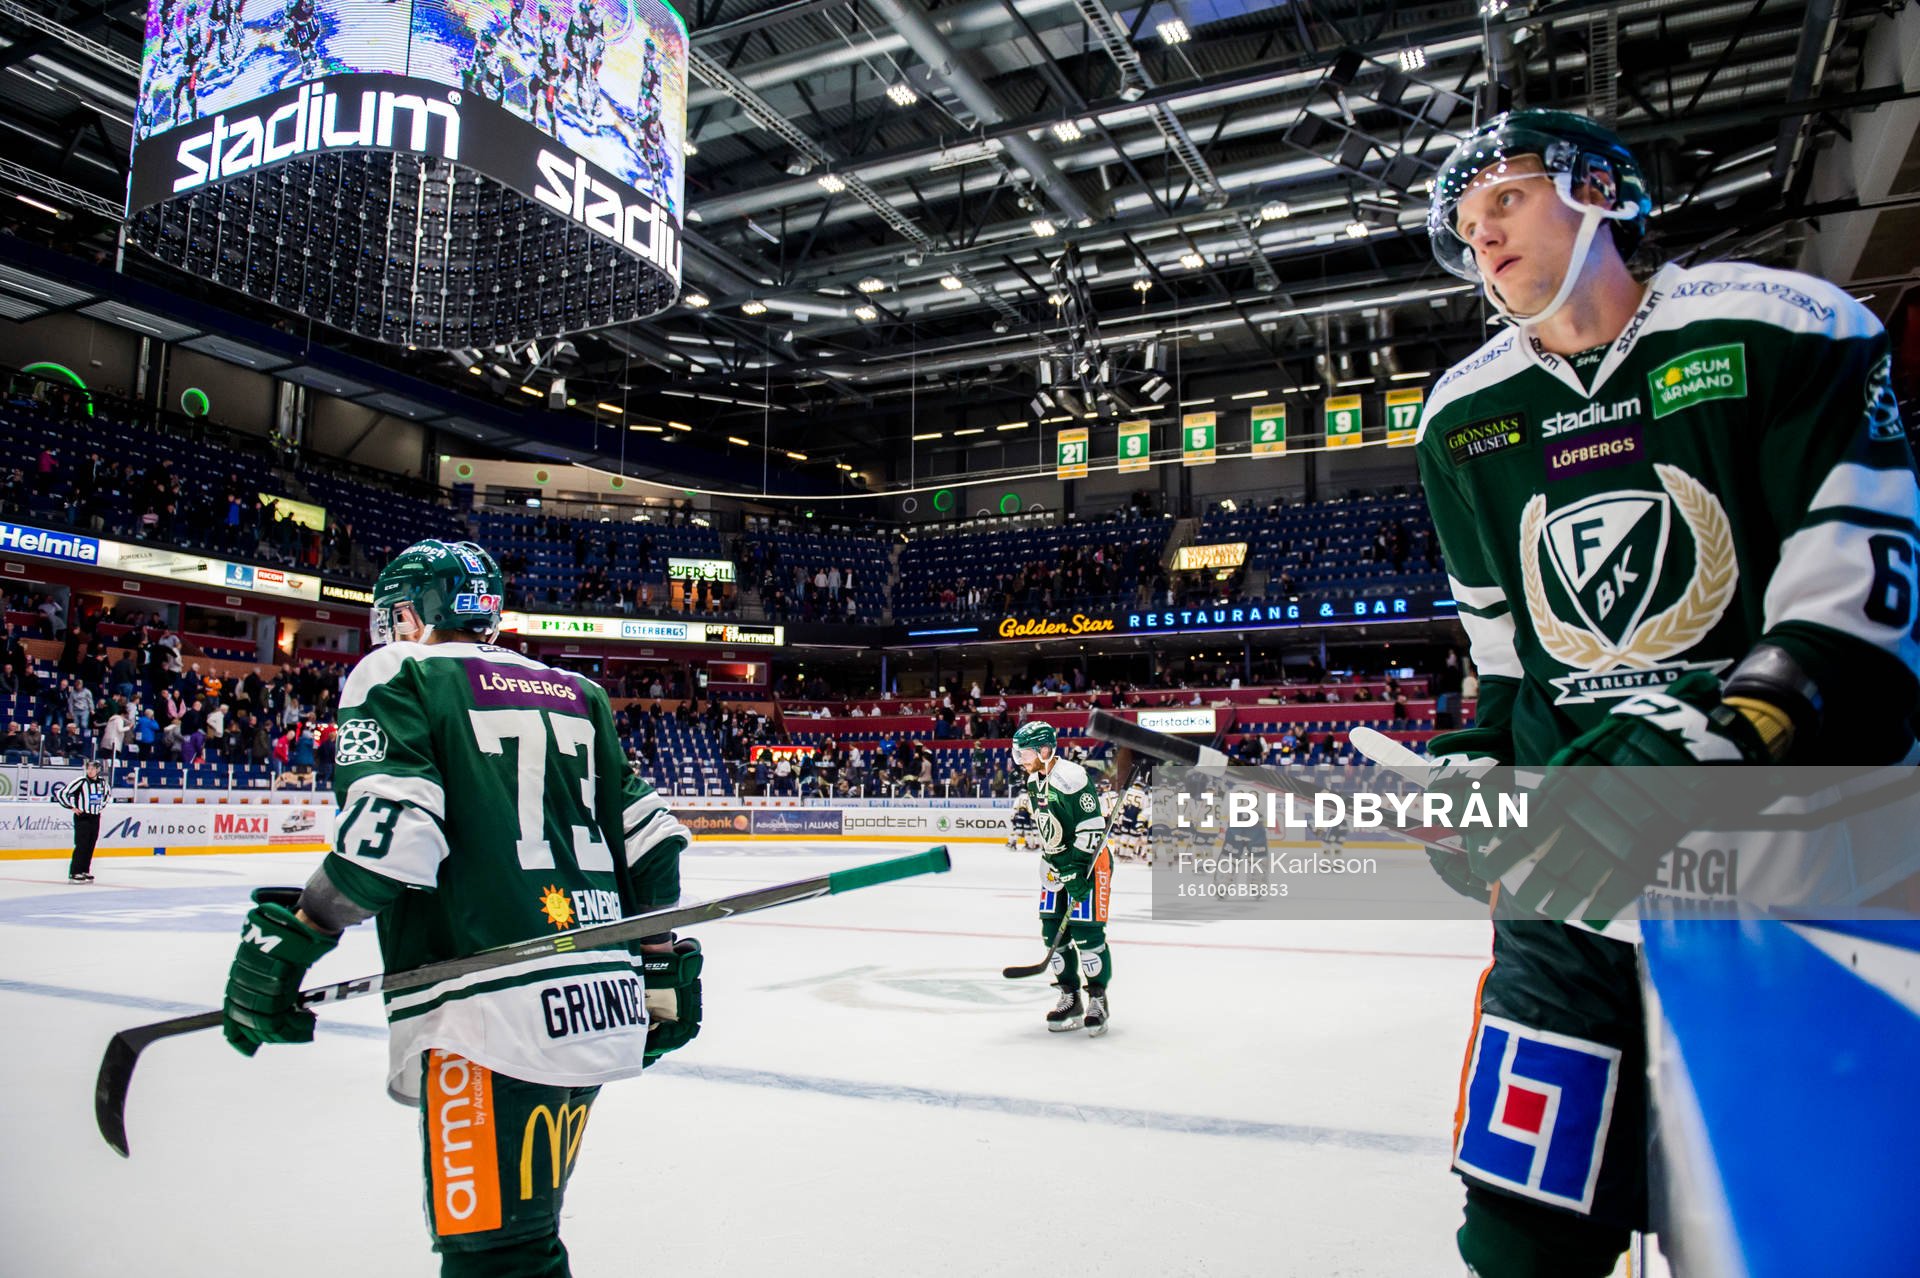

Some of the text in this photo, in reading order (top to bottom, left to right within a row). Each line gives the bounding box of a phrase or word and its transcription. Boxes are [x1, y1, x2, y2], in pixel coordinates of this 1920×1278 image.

[173, 83, 459, 193] stadium
[534, 148, 682, 283] stadiu
[1617, 290, 1664, 354] stadium
[1335, 411, 1352, 433] 9
[1392, 405, 1417, 428] 17
[1541, 397, 1641, 438] stadium
[1191, 428, 1207, 448] 5
[1260, 420, 1277, 441] 2
[1449, 417, 1519, 449] GRÖNSAKS
[1062, 443, 1084, 464] 21
[1126, 436, 1141, 456] 9
[1467, 432, 1509, 455] HUSET
[1552, 437, 1635, 469] LÖFBERGS
[0, 525, 97, 561] Helmia
[541, 620, 595, 633] PEAB
[999, 599, 1407, 638] Golden Star RESTAURANG & BAR
[479, 672, 577, 700] LÖFBERGS
[1579, 670, 1679, 691] KARLSTAD
[468, 709, 615, 873] 73
[12, 815, 75, 831] Matthiess
[147, 824, 208, 835] MIDROC
[678, 815, 732, 829] wedbank
[844, 815, 927, 830] goodtech
[955, 817, 1007, 829] ŠKODA
[571, 889, 622, 921] ENERG
[474, 1110, 487, 1126] by
